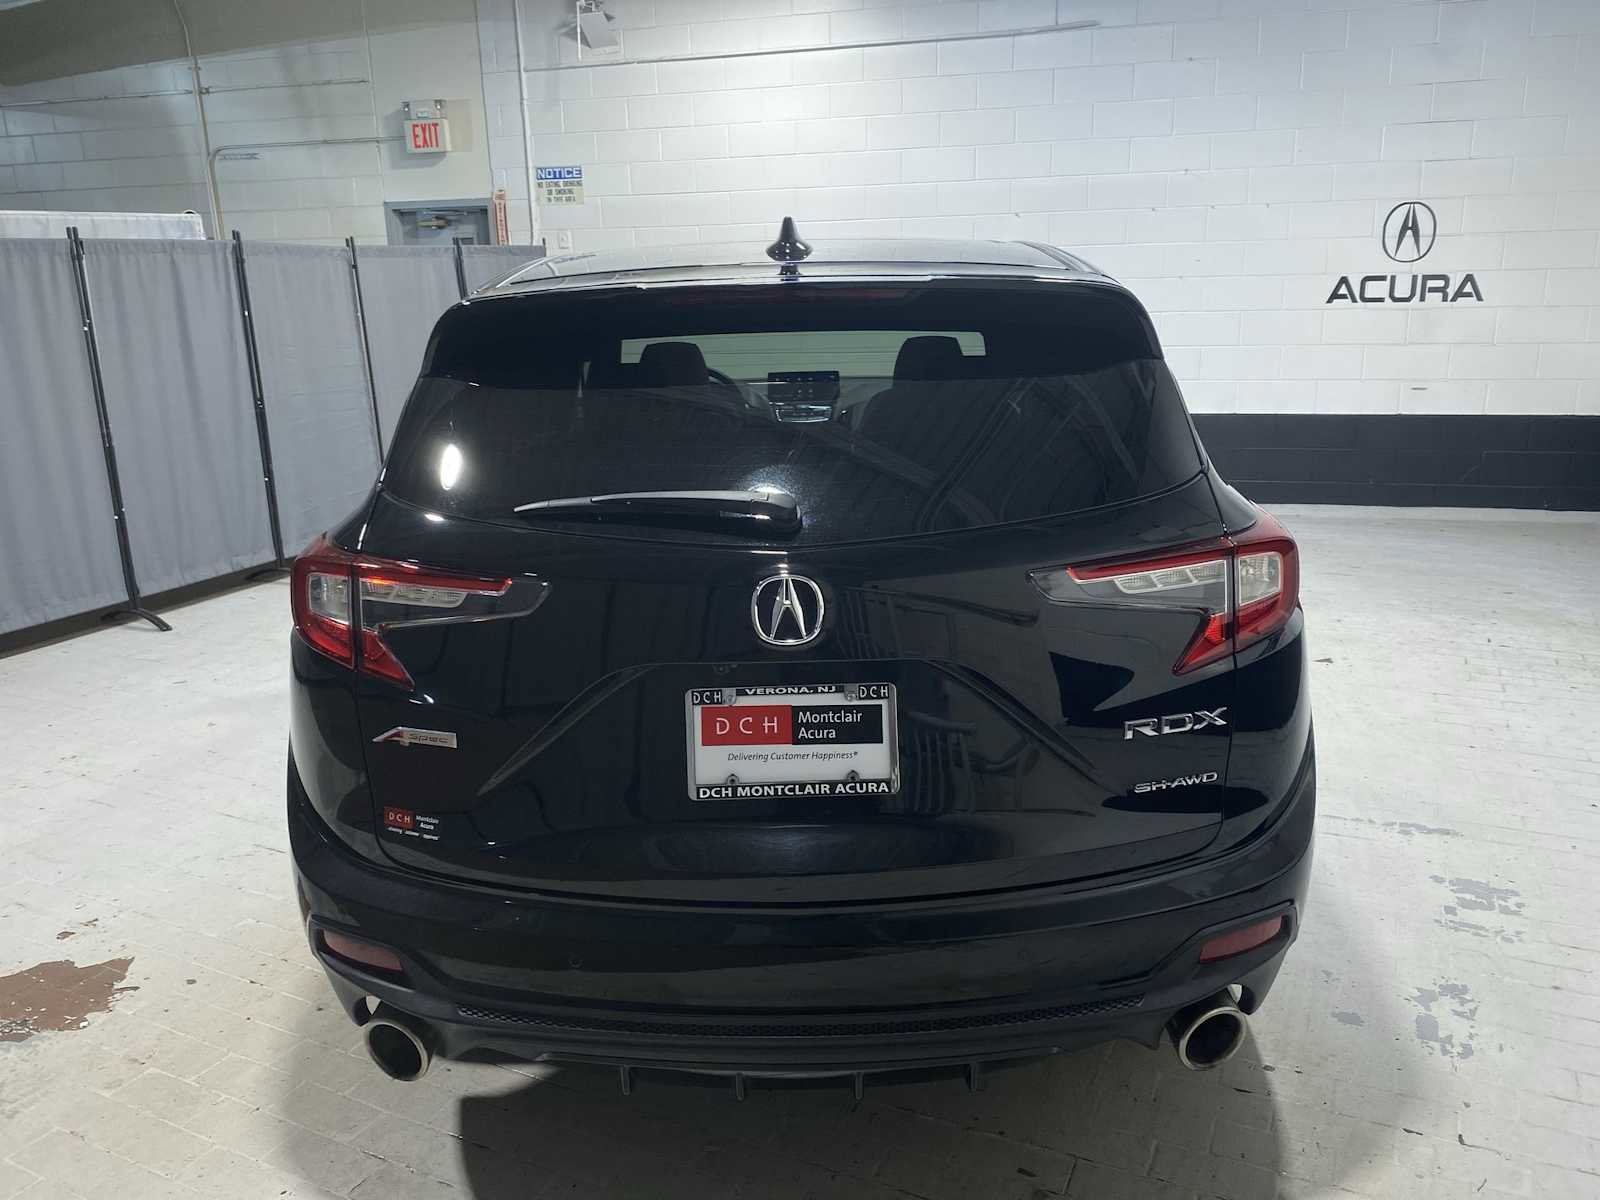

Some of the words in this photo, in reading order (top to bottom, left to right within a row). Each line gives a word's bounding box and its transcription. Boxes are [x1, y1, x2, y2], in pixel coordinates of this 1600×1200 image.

[412, 123, 439, 149] EXIT
[537, 167, 581, 179] NOTICE
[1325, 273, 1484, 304] ACURA
[817, 685, 836, 693] NJ
[859, 685, 889, 698] DCH
[693, 691, 722, 704] DCH
[798, 710, 863, 724] Montclair
[1123, 706, 1228, 740] RDX
[716, 716, 778, 735] DCH
[798, 727, 837, 739] Acura
[727, 752, 769, 762] Delivering
[770, 752, 811, 760] Customer
[1133, 771, 1218, 794] SH-AWD
[699, 786, 732, 799] DCH
[736, 783, 831, 797] MONTCLAIR
[834, 782, 890, 794] ACURA
[388, 811, 411, 824] DCH
